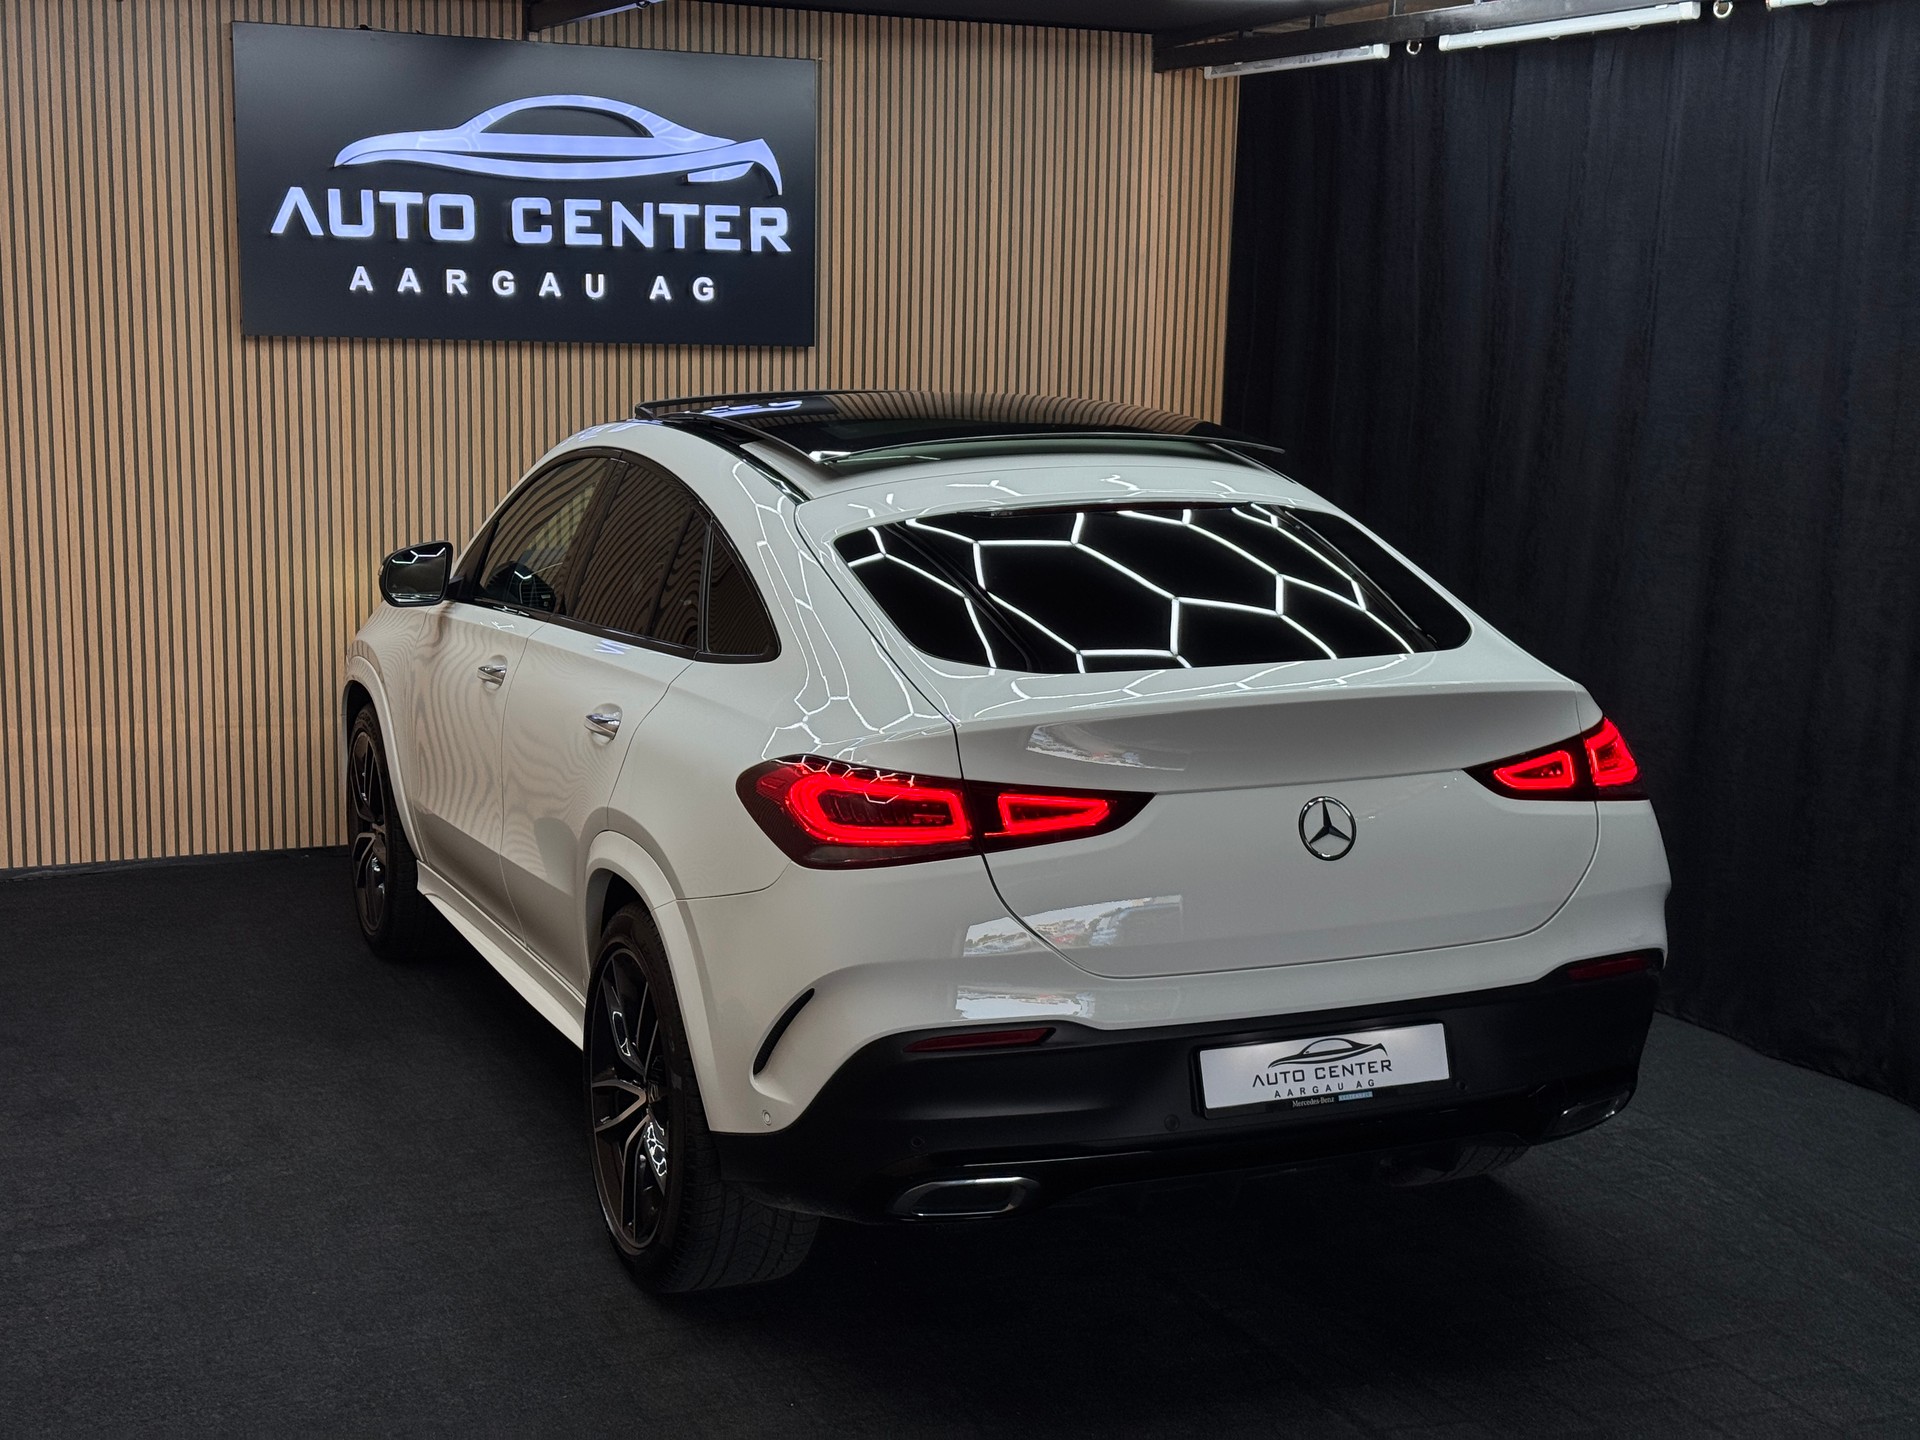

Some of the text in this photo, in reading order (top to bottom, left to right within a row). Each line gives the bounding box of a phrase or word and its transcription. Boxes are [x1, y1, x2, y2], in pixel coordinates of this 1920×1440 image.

[270, 185, 793, 254] AUTO CENTER
[348, 264, 716, 302] AARGAU AG
[1252, 1059, 1393, 1088] AUTO CENTER
[1274, 1082, 1344, 1099] AARGAU
[1355, 1078, 1375, 1089] AG
[1291, 1096, 1335, 1108] Mercedes-Benz
